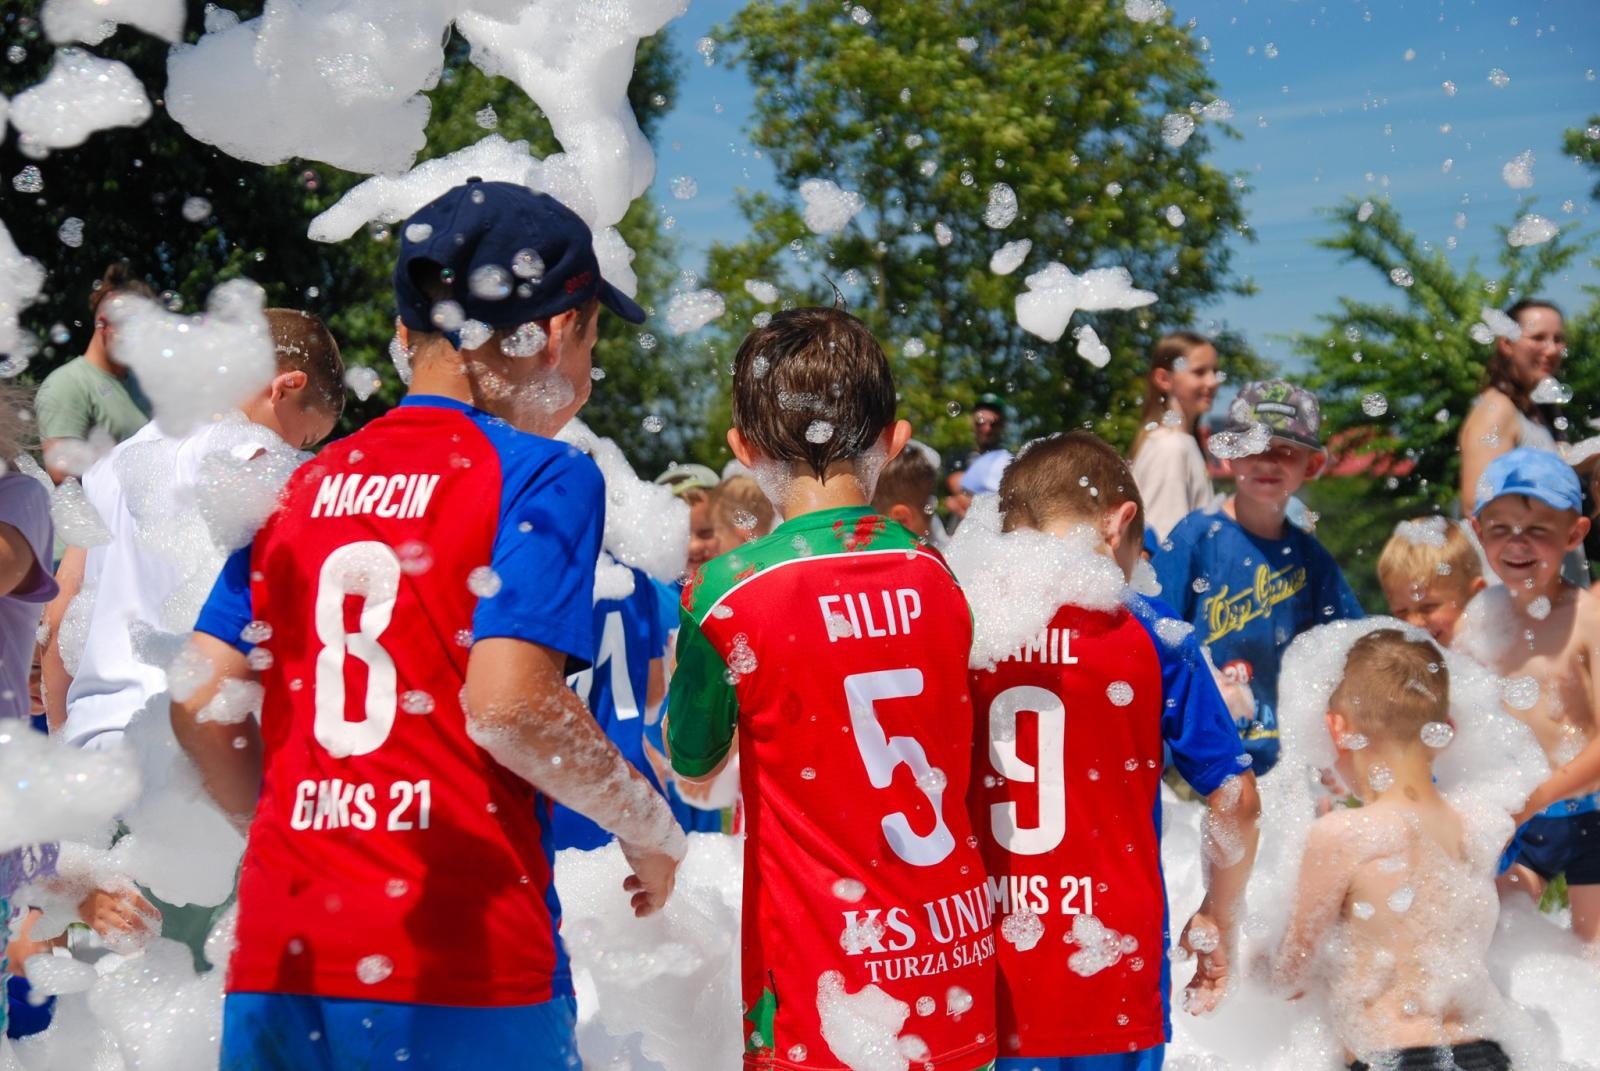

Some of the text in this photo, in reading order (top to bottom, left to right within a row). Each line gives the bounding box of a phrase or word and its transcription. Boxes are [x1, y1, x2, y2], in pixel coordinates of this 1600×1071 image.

[311, 473, 439, 518] MARCIN
[818, 588, 921, 642] FILIP
[314, 540, 401, 758] 8
[1001, 628, 1079, 664] MIL
[844, 668, 956, 866] 5
[989, 685, 1066, 855] 9
[387, 779, 431, 832] 21
[987, 875, 1092, 915] MKS 21
[842, 907, 916, 955] KS
[865, 933, 995, 983] TURZA ŚLĄSK
